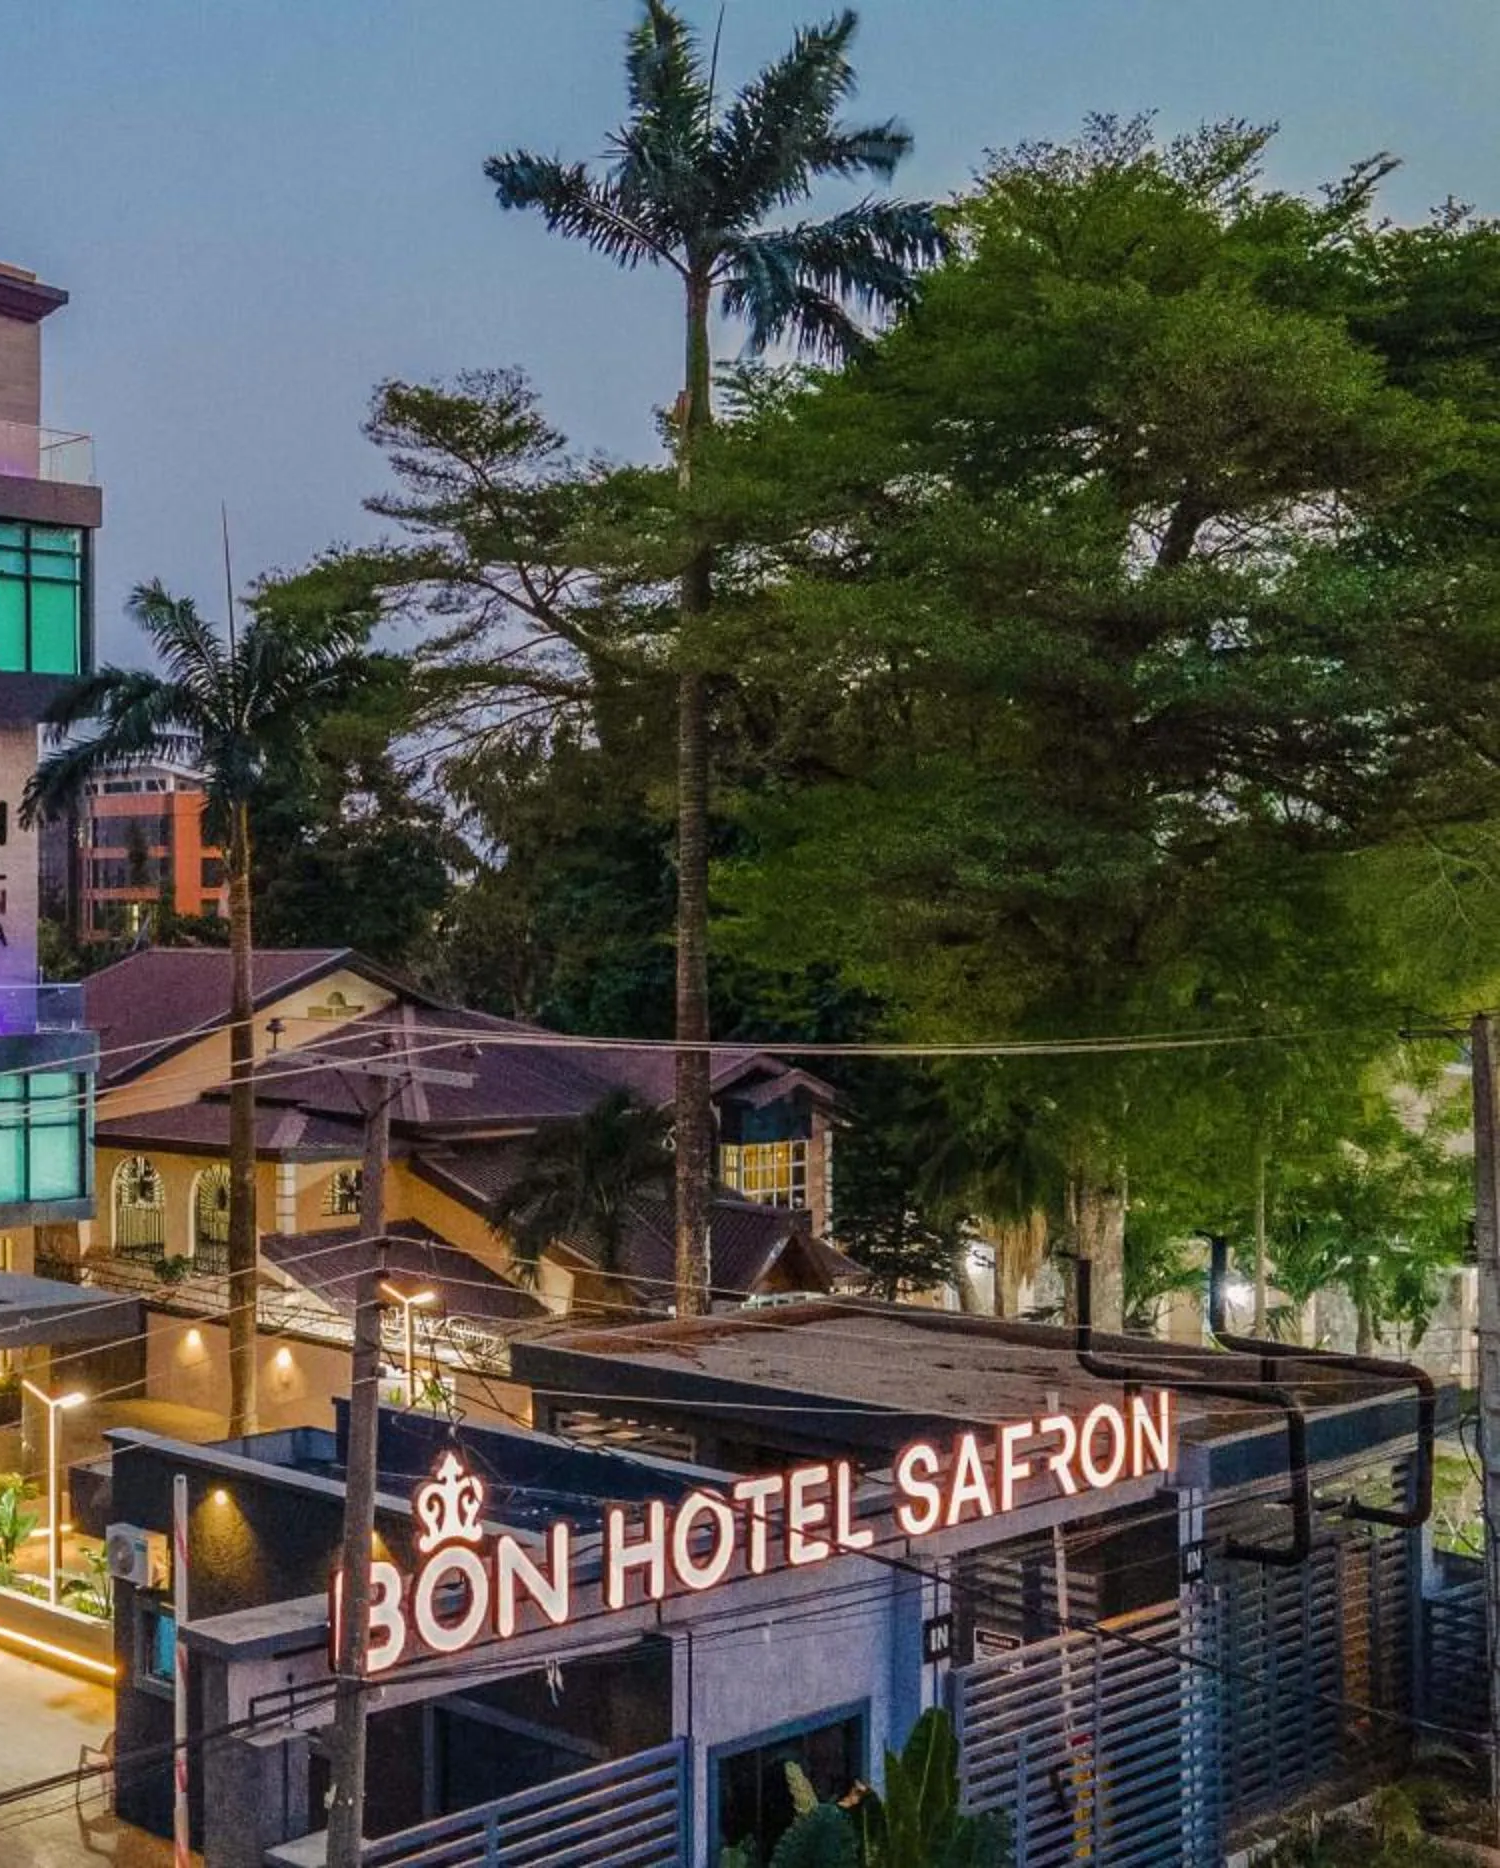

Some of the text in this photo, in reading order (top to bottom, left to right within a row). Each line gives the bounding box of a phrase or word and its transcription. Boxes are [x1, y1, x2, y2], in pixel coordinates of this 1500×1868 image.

[333, 1391, 1171, 1673] BON HOTEL SAFRON
[1186, 1548, 1202, 1574] IN
[930, 1623, 950, 1654] IN
